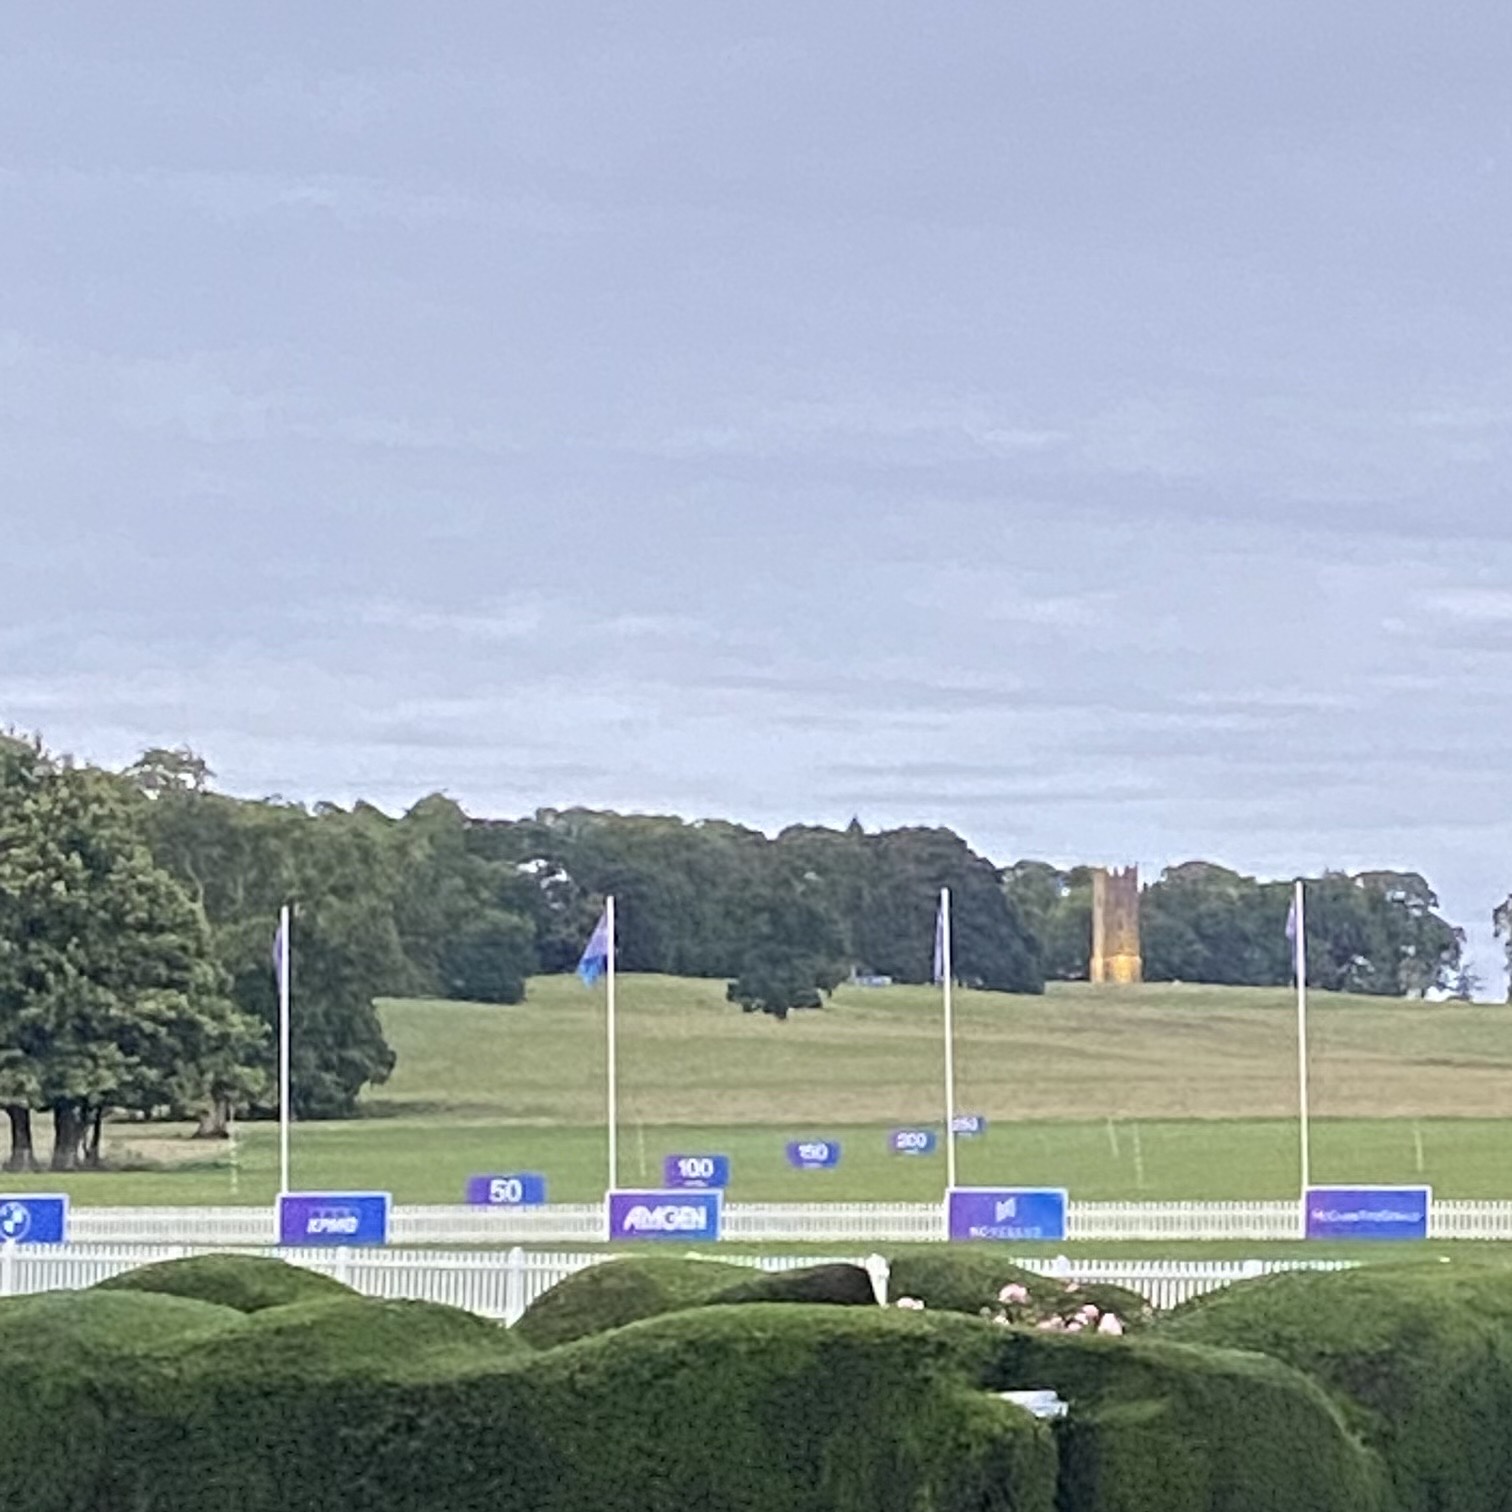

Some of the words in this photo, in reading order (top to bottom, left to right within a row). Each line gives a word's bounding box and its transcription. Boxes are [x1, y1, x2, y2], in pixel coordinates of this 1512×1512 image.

[678, 1158, 714, 1179] 100
[489, 1179, 522, 1202] 50
[623, 1205, 707, 1231] AMGEN
